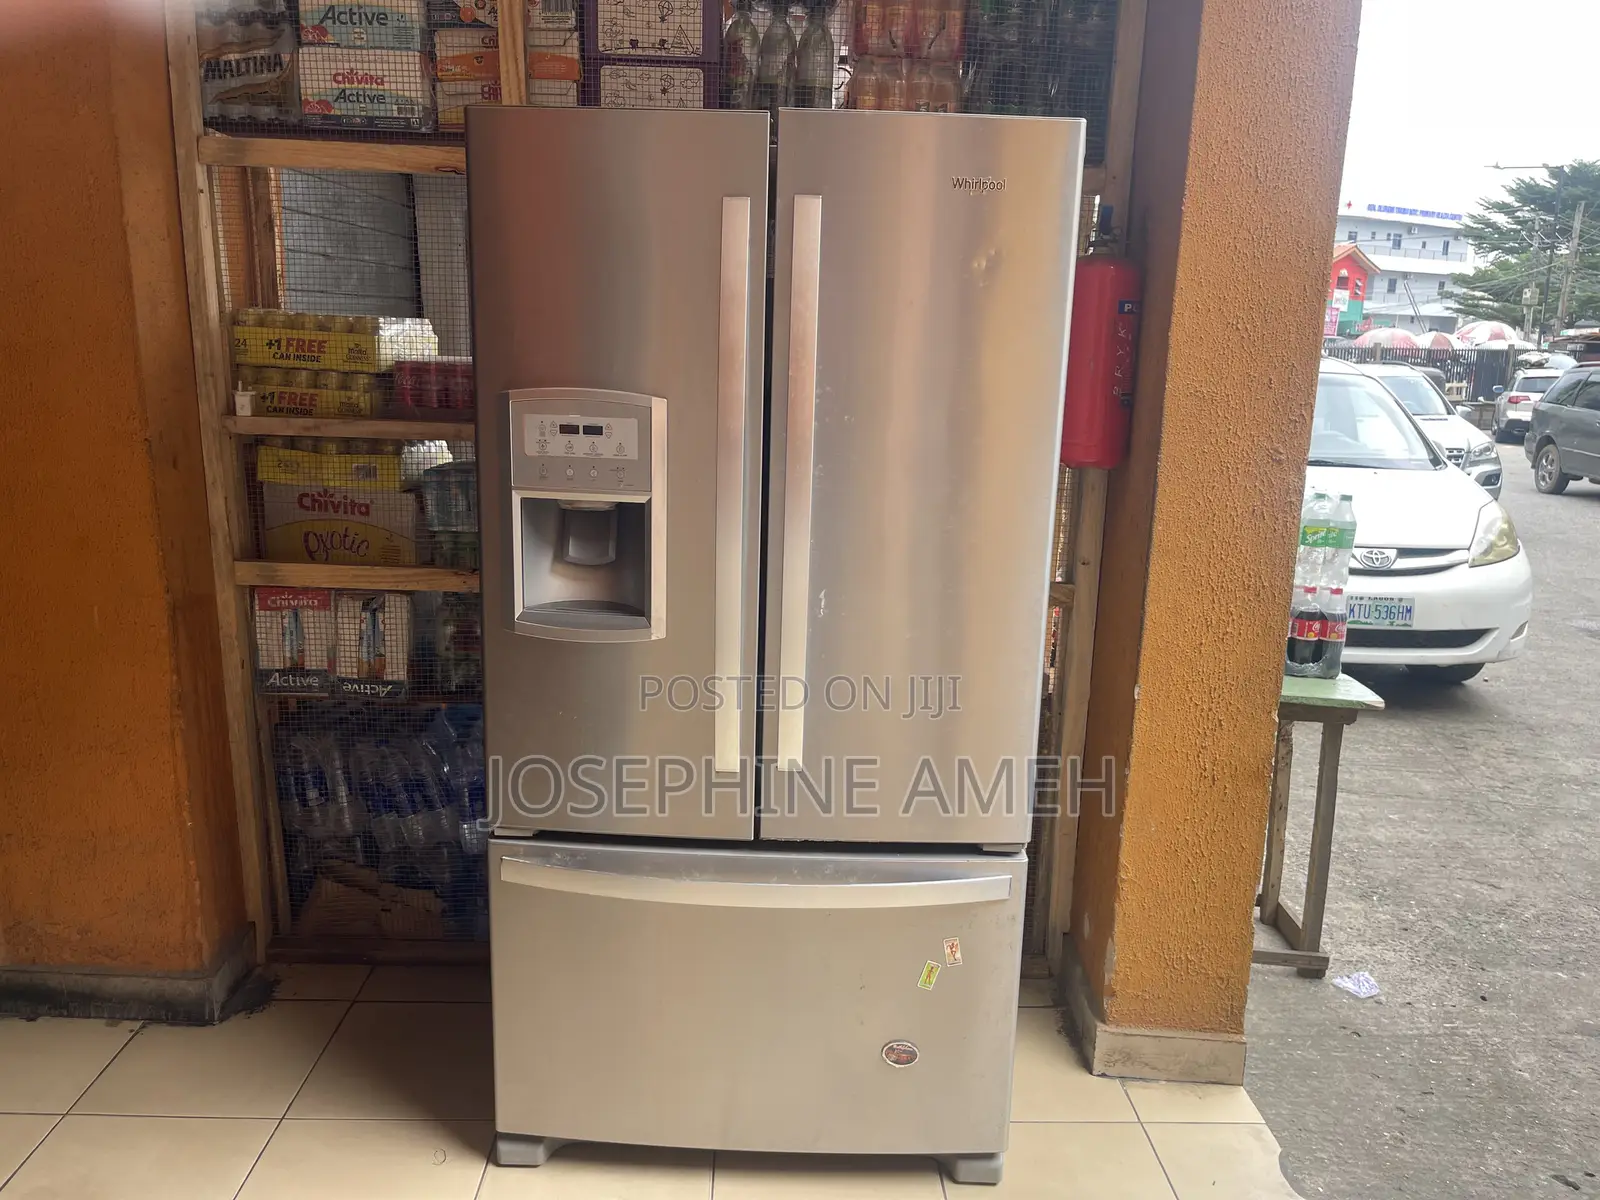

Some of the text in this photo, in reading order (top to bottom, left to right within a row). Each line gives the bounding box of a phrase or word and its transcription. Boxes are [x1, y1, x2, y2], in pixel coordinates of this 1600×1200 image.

[319, 4, 388, 26] Active
[333, 89, 386, 104] Active
[951, 177, 1006, 194] Whirlpool
[285, 337, 329, 354] FREE
[272, 351, 321, 363] CAN INSIDE
[278, 391, 318, 408] FREE
[266, 405, 314, 416] CAN INSIDE
[297, 489, 370, 516] Chivita
[266, 671, 319, 687] Active
